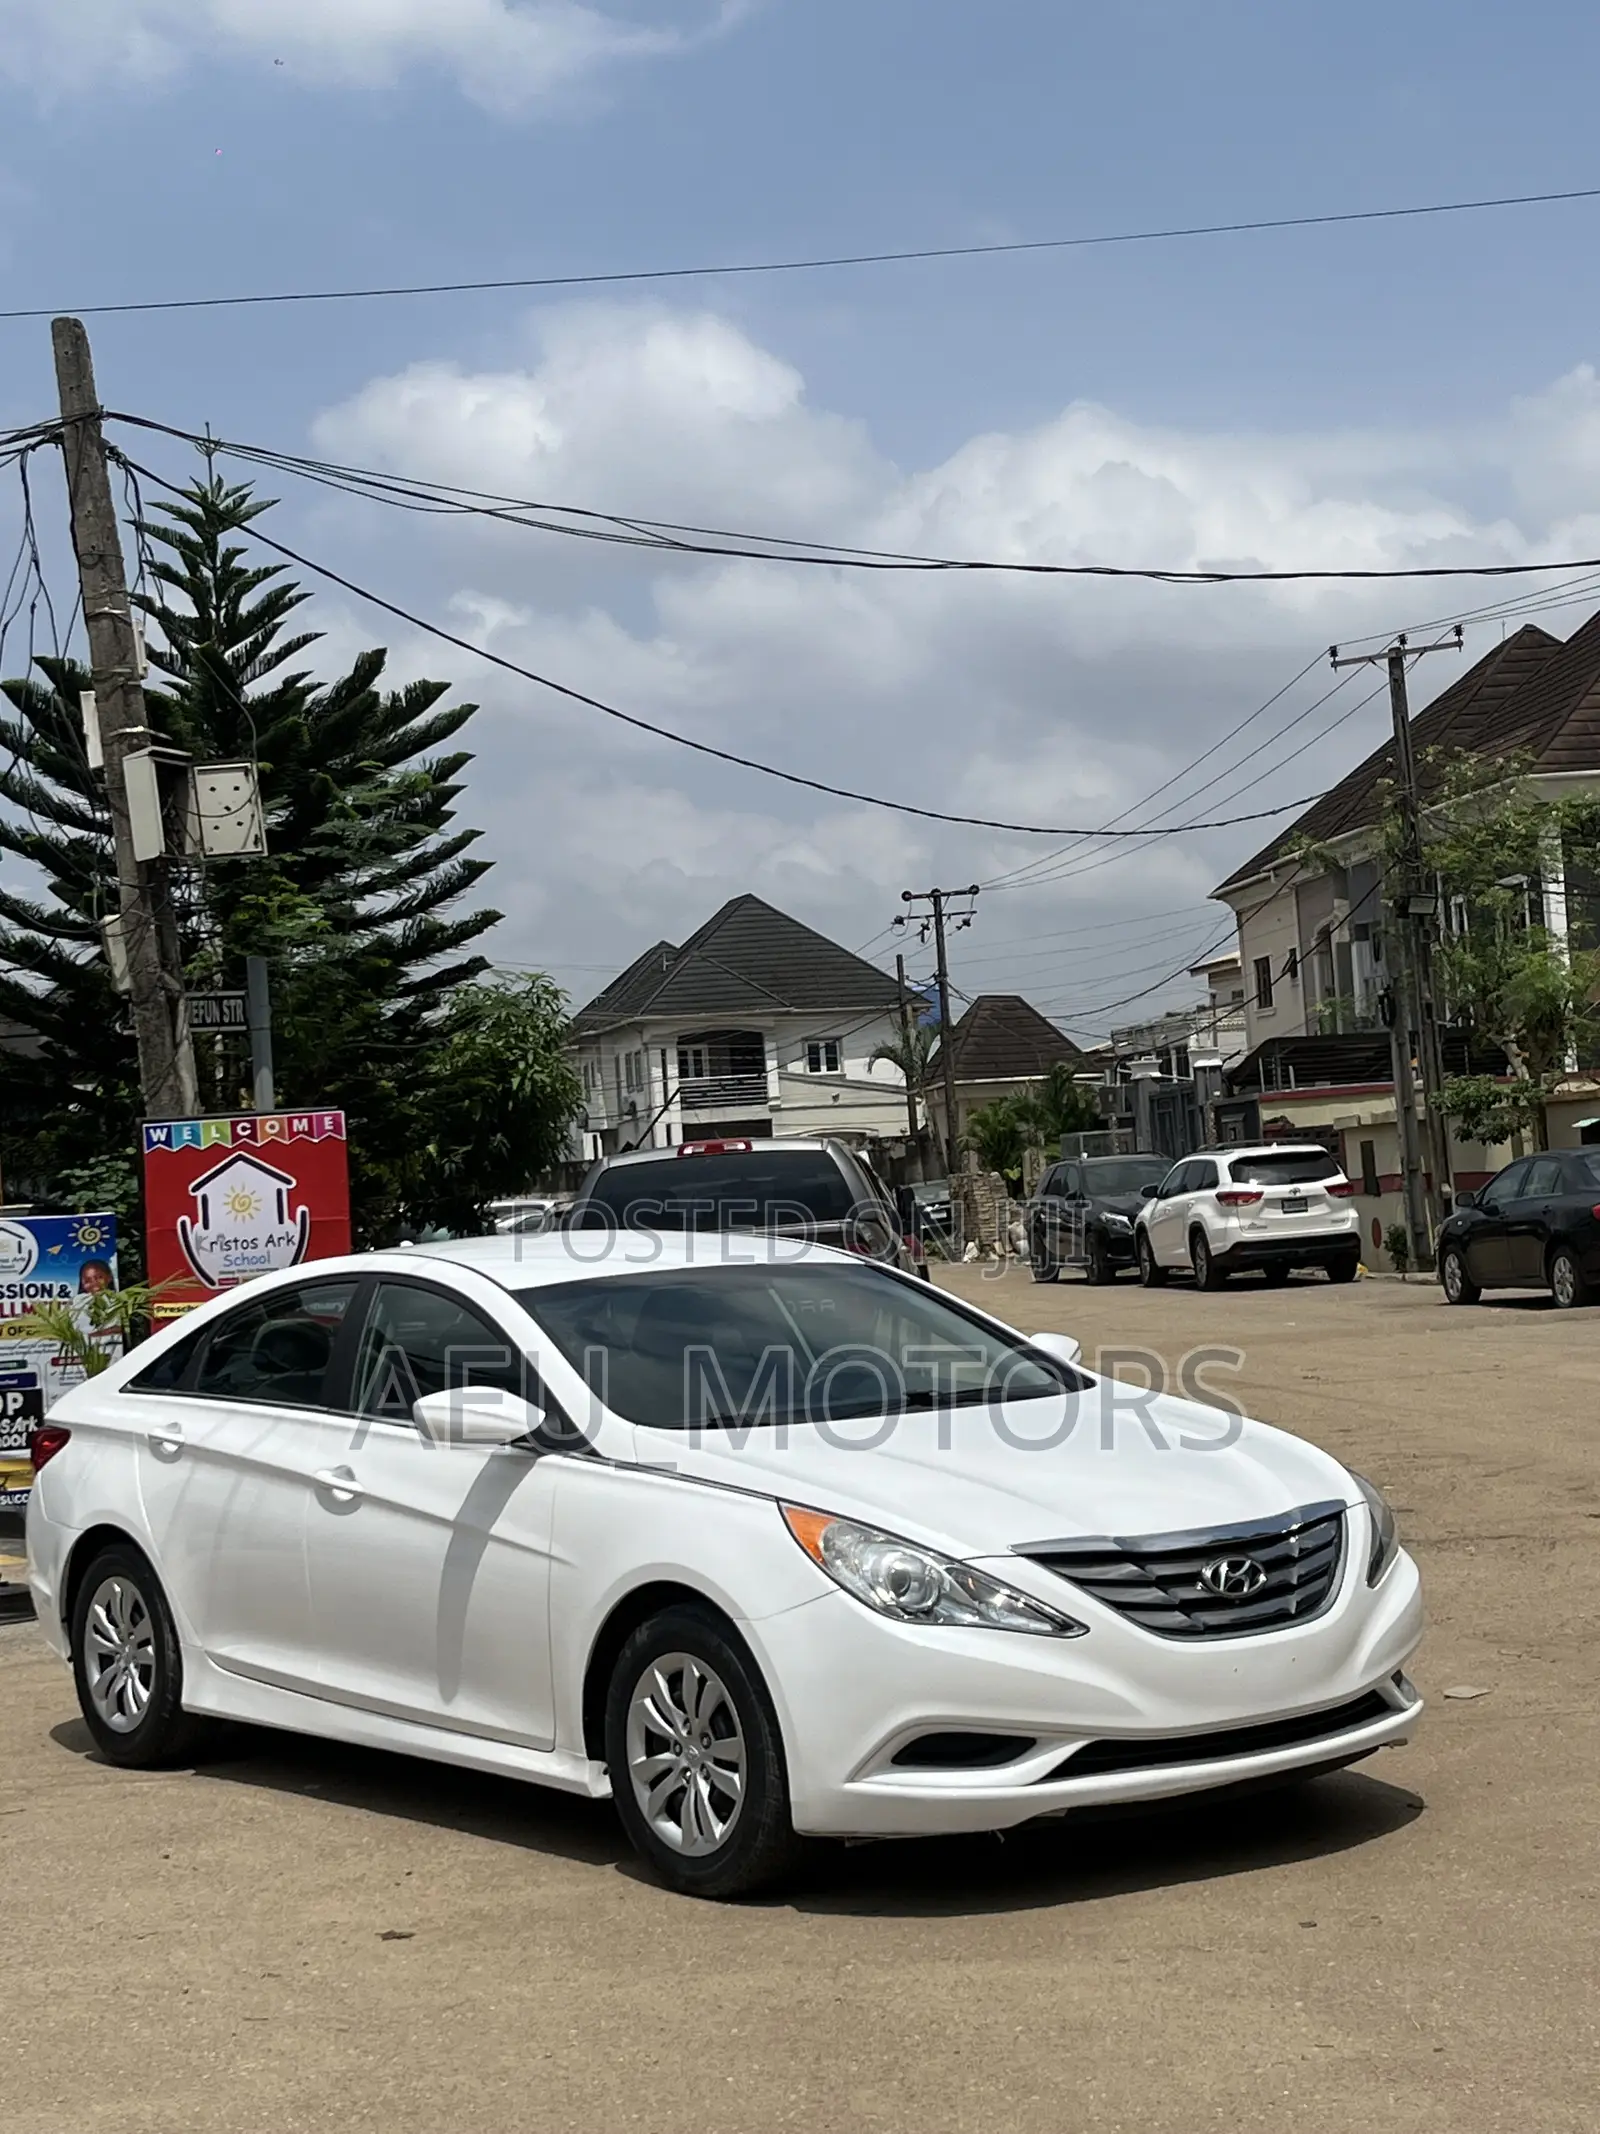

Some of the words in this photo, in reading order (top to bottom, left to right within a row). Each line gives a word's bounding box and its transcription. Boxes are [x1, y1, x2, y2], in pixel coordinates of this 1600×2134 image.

[222, 999, 245, 1024] STR
[148, 1116, 336, 1142] WELCOME
[195, 1231, 259, 1256] Kristos
[265, 1230, 297, 1249] Ark
[223, 1250, 271, 1268] School
[57, 1283, 72, 1299] &
[0, 1391, 25, 1416] P
[0, 1432, 28, 1448] ool
